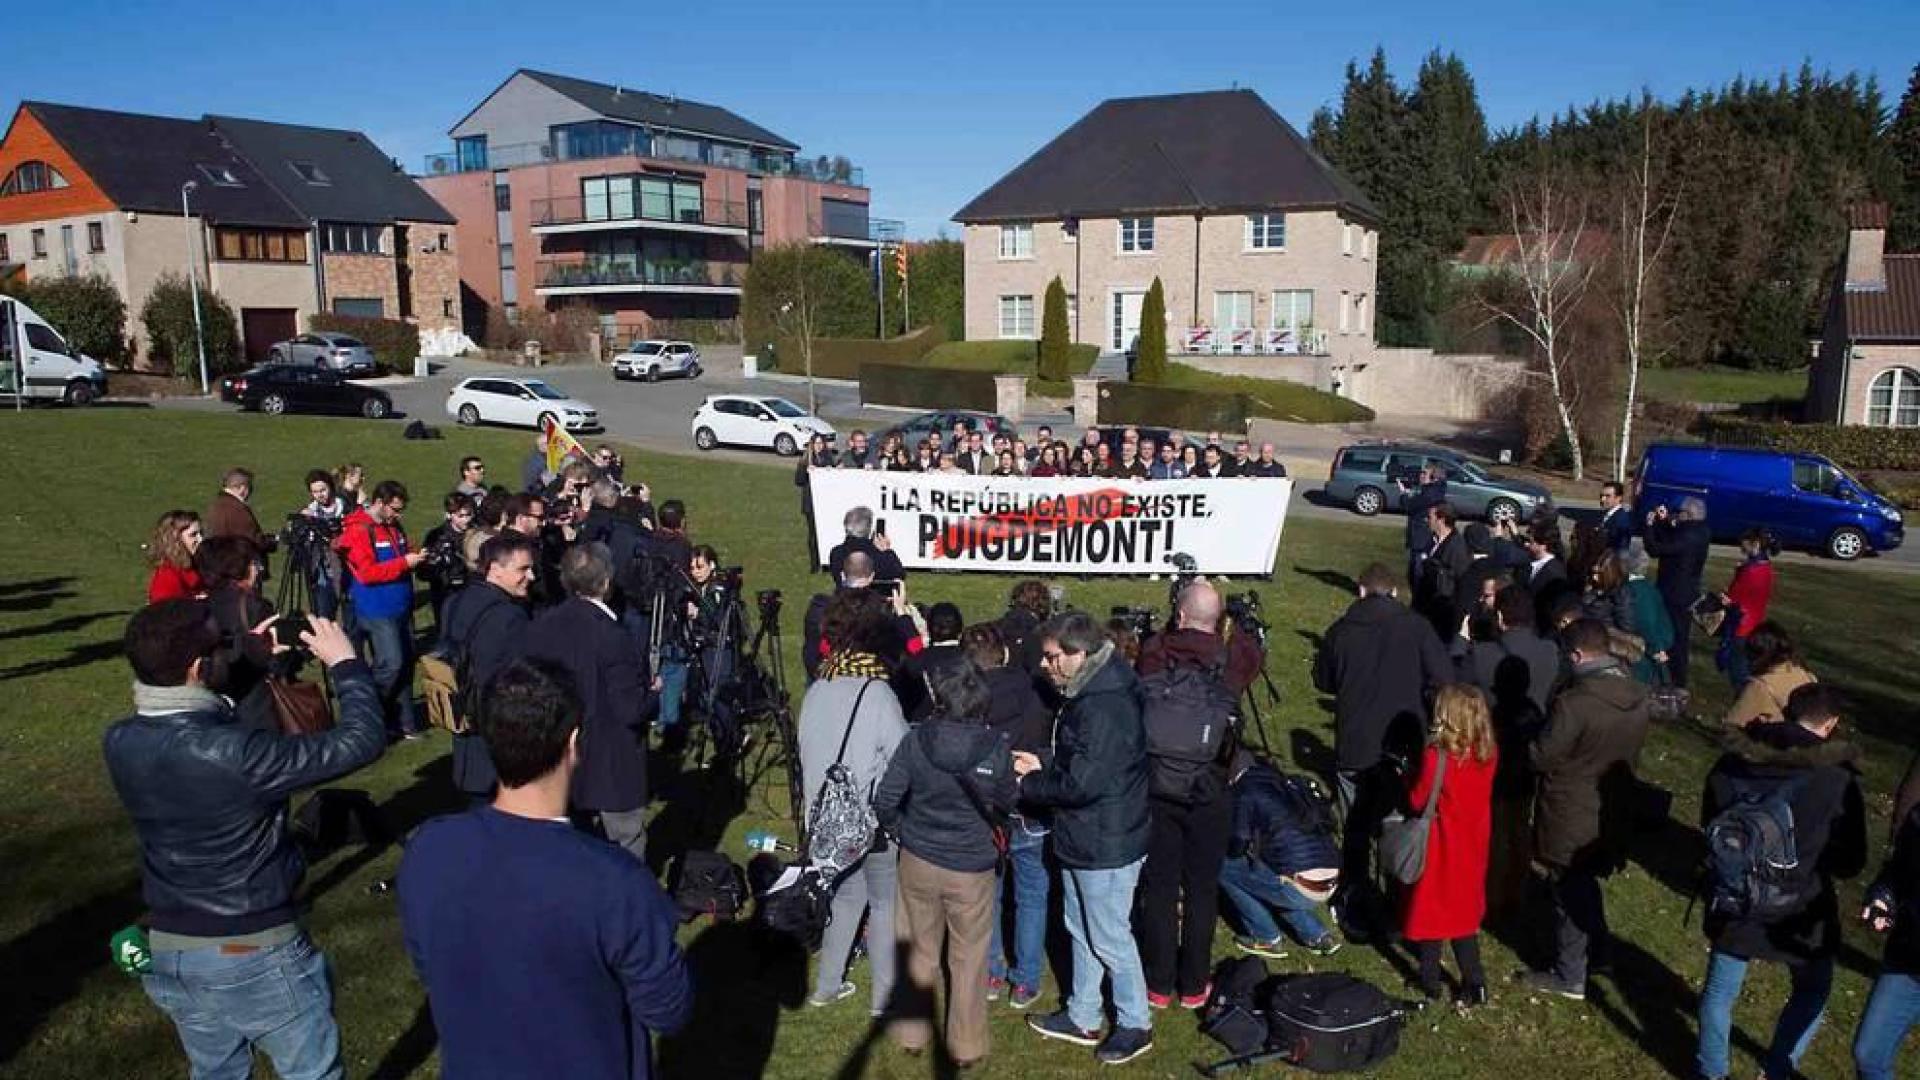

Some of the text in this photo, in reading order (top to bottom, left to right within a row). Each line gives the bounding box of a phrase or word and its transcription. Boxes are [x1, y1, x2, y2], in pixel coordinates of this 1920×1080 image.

[930, 486, 1068, 519] REPÚBLICA
[1077, 493, 1113, 519] NO
[1120, 493, 1213, 519] EXISTE,
[918, 513, 1175, 565] PUIGDEMONT!
